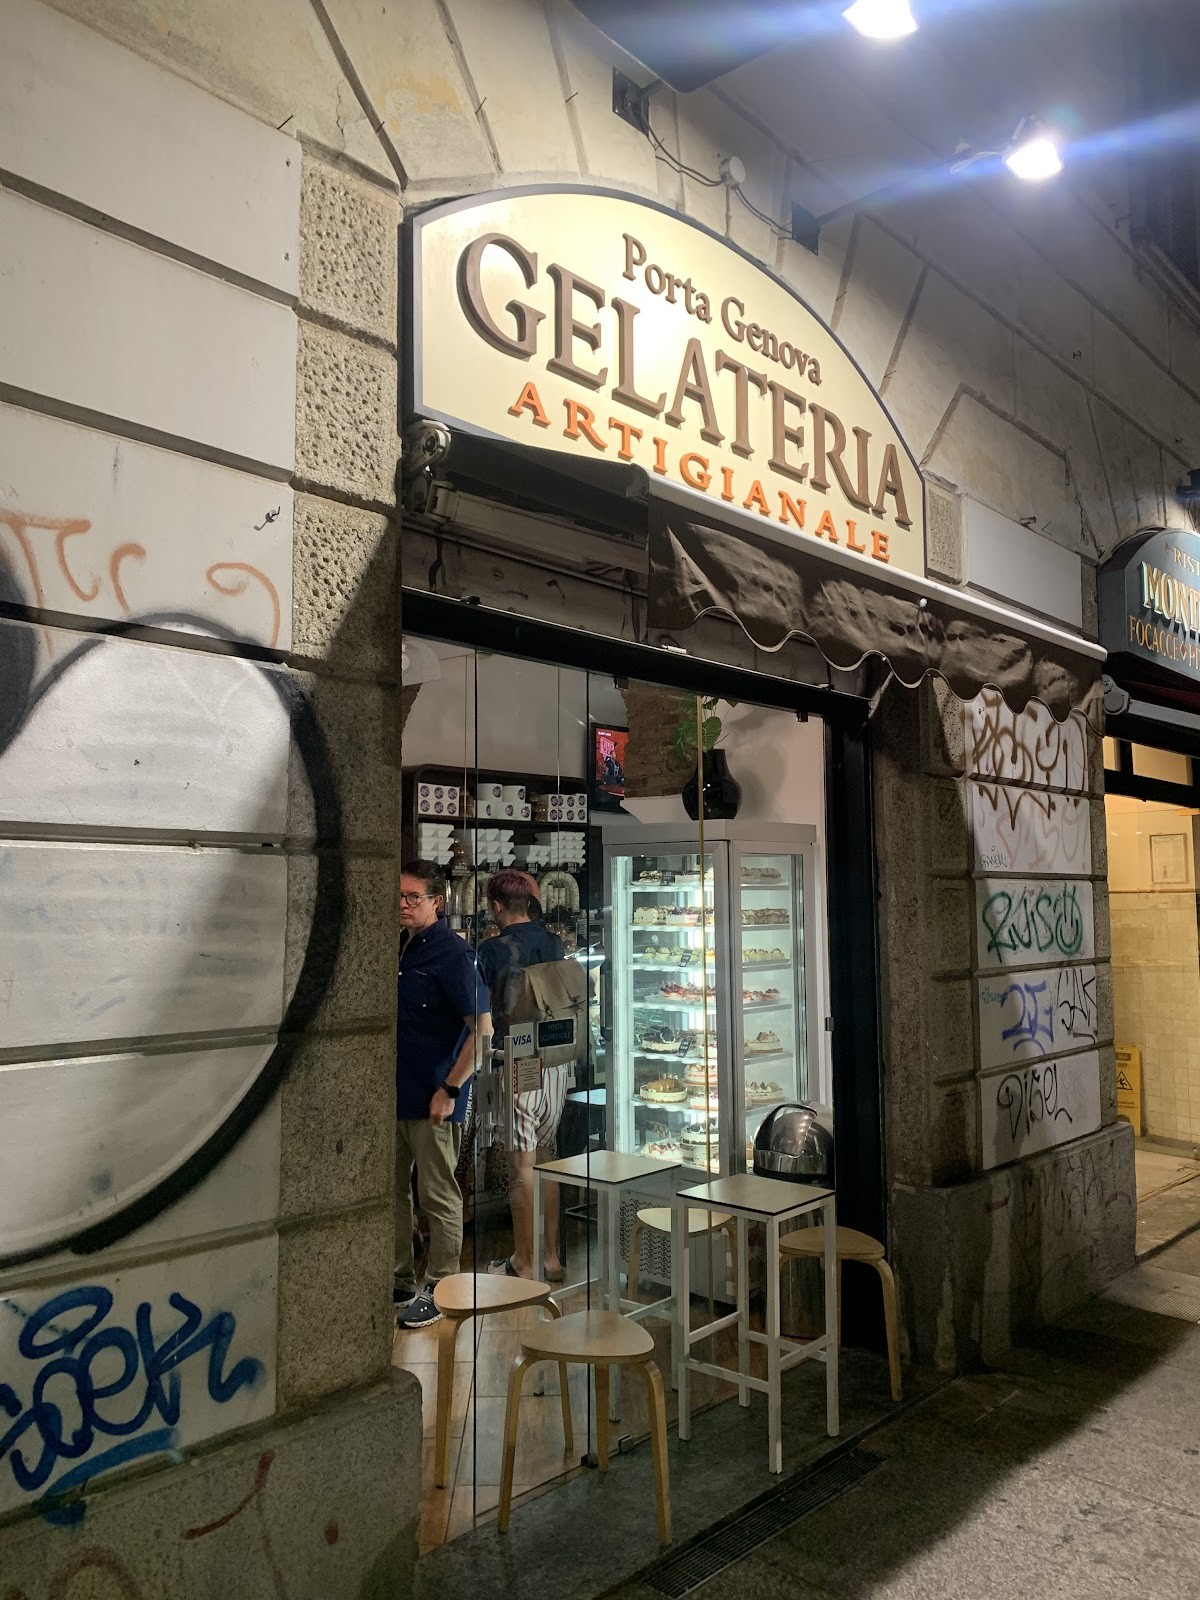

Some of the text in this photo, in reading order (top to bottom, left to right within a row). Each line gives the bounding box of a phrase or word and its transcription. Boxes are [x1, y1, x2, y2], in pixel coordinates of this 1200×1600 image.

[622, 233, 822, 386] Porta Genova
[456, 232, 913, 531] GELATERIA
[508, 381, 891, 563] ARTIGIANALE
[1129, 615, 1200, 670] FOCACCE PI
[1141, 560, 1200, 634] MONT
[513, 1034, 532, 1046] VISA
